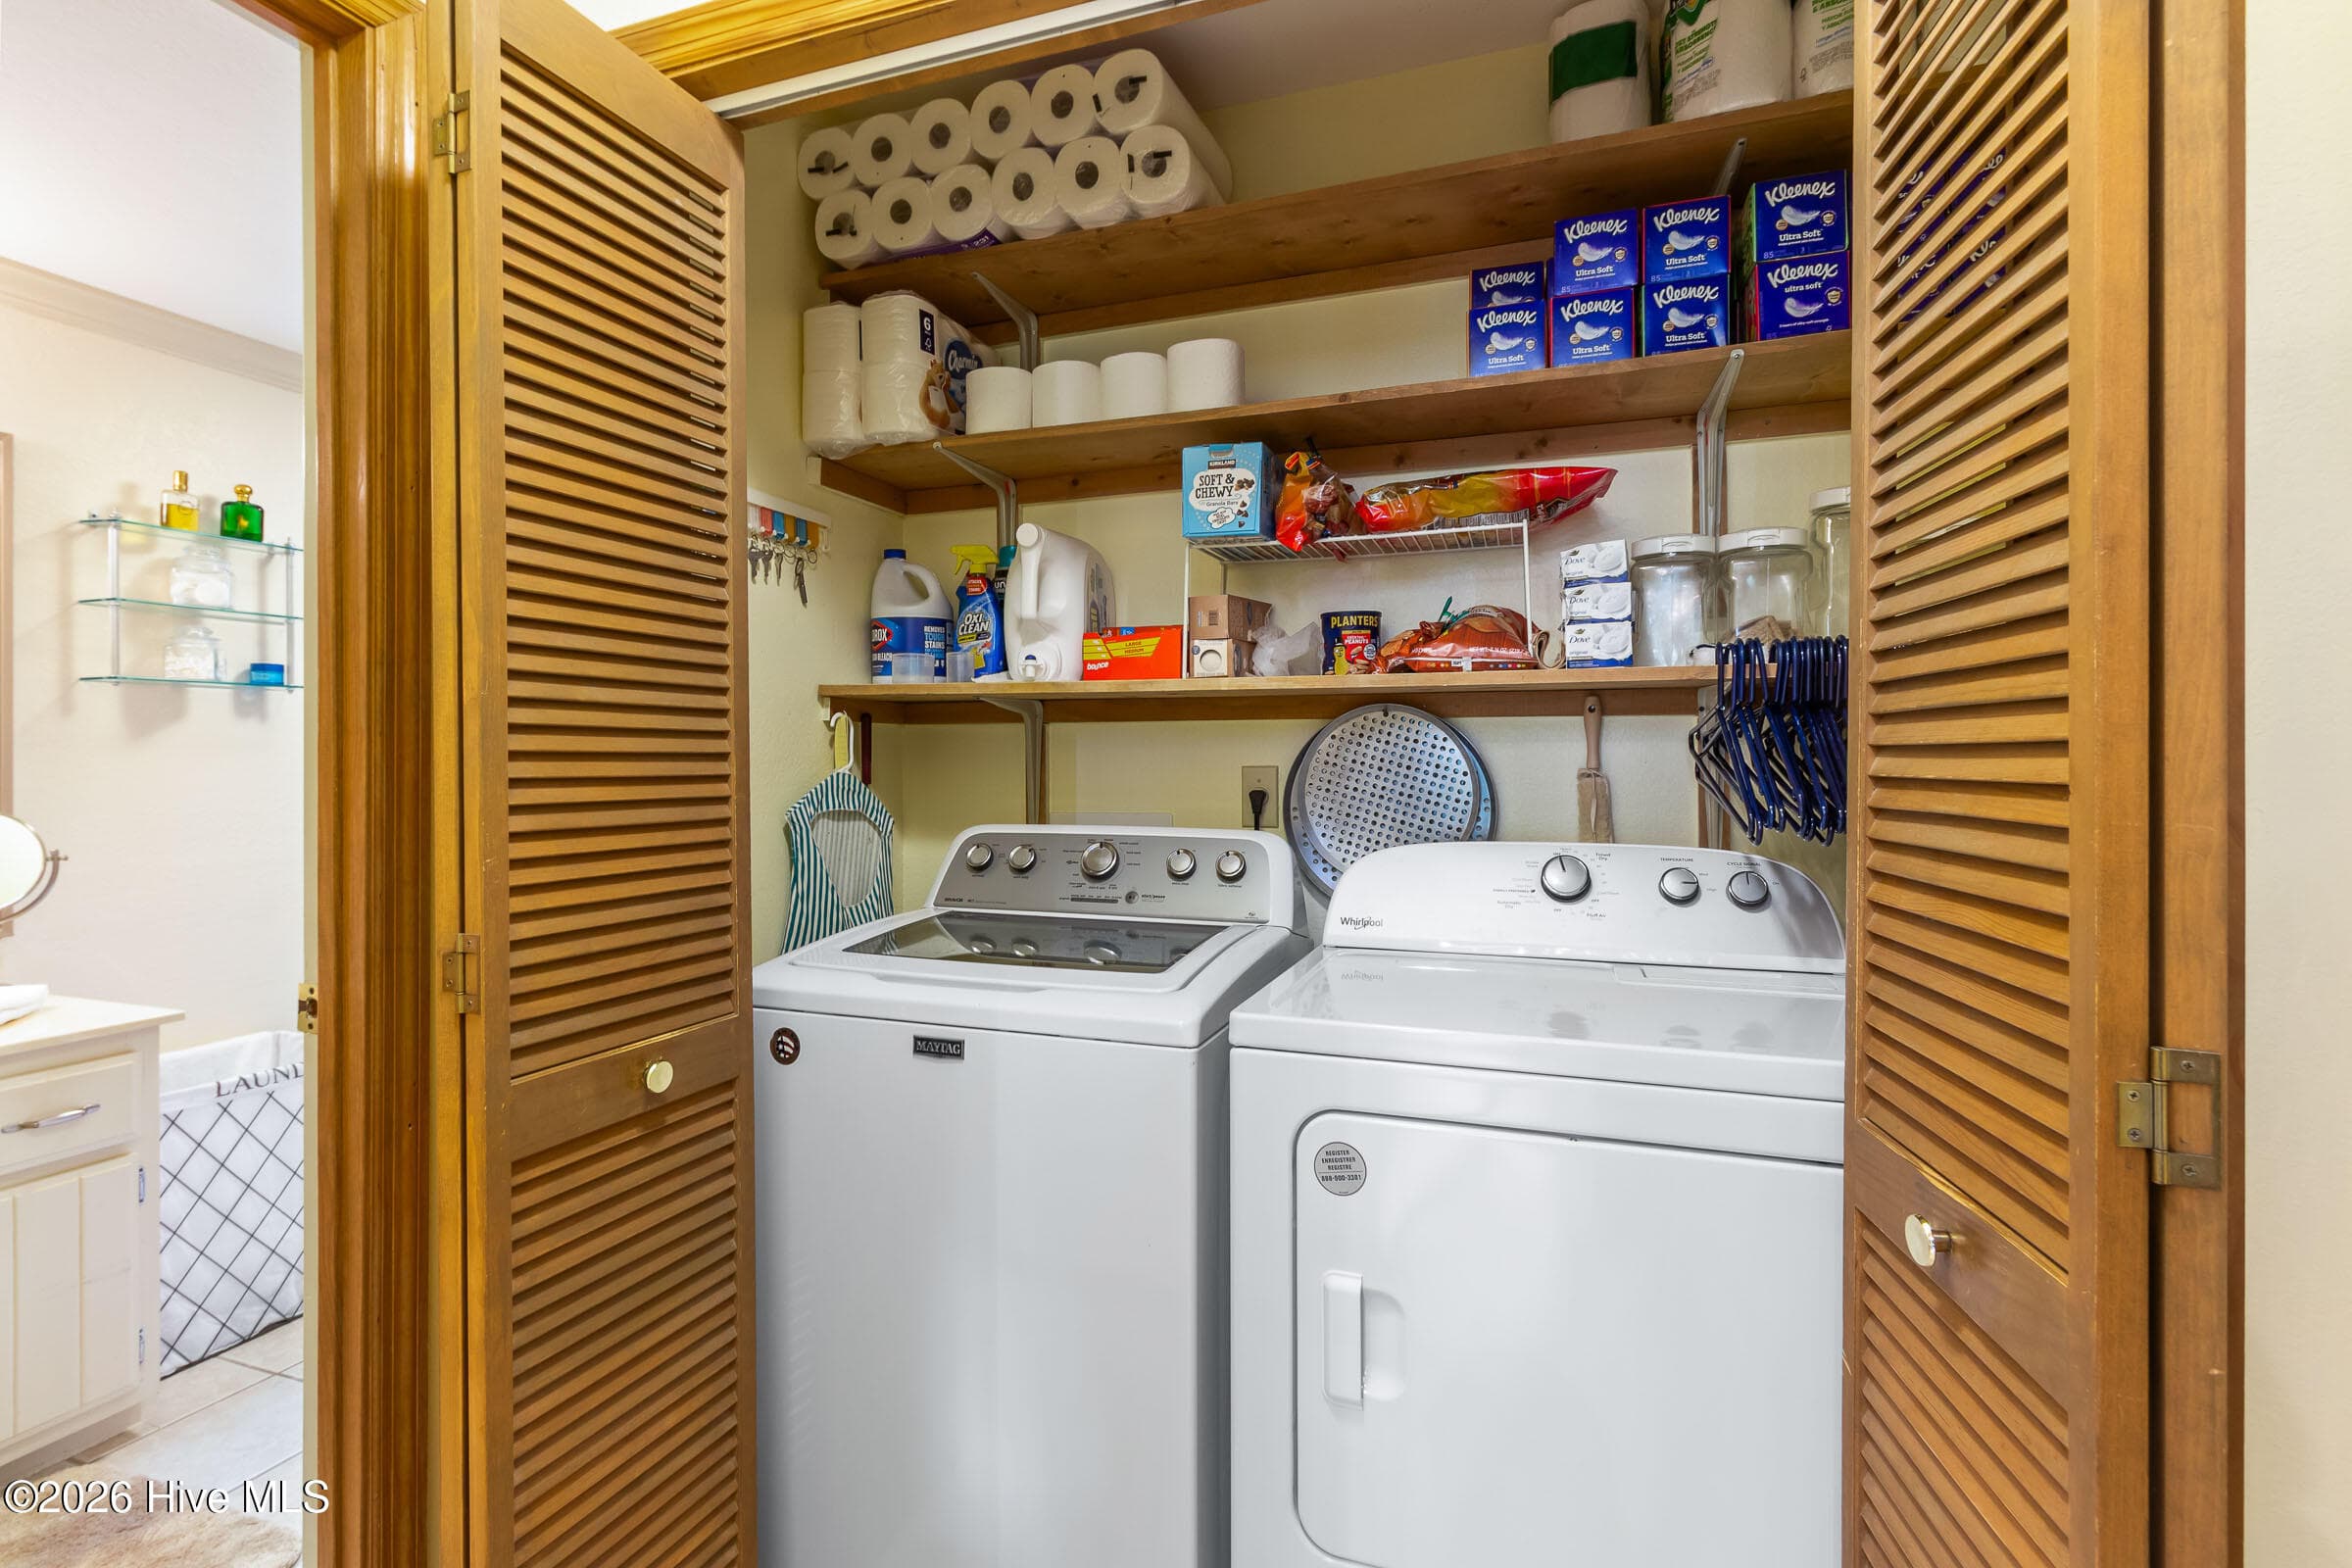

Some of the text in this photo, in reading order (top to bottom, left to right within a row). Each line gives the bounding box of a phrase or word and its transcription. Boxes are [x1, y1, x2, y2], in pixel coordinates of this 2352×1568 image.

[1765, 180, 1836, 207] Kleenex
[1653, 207, 1720, 232] Kleenex
[1563, 219, 1628, 244] Kleenex
[1779, 232, 1801, 242] Ultra
[1802, 229, 1822, 239] Soft
[1665, 254, 1705, 266] Ultra Soft
[1576, 269, 1595, 277] Ultra
[1596, 266, 1614, 275] Soft
[1767, 263, 1838, 288] Kleenex
[1480, 270, 1536, 292] Kleenex
[1785, 281, 1822, 293] ultra soft
[1653, 285, 1719, 309] Kleenex
[1561, 299, 1624, 322] Kleenex
[923, 317, 931, 331] 6
[1477, 310, 1537, 332] Kleenex
[1665, 330, 1705, 342] Ultra Soft
[1572, 346, 1592, 355] Ultra
[1592, 344, 1610, 353] Soft
[948, 350, 979, 371] Charmin
[1507, 354, 1525, 364] Soft
[1199, 473, 1236, 487] SOFT &
[1195, 485, 1235, 499] CHEWY
[1564, 557, 1586, 565] Dove
[1569, 595, 1590, 605] Dove
[964, 613, 983, 623] OXI
[1331, 615, 1379, 629] PLANTERS
[958, 620, 990, 635] CLEAN
[1569, 635, 1591, 644] Dove
[1340, 916, 1384, 930] Whirlpool
[916, 1040, 961, 1054] MAYTAG
